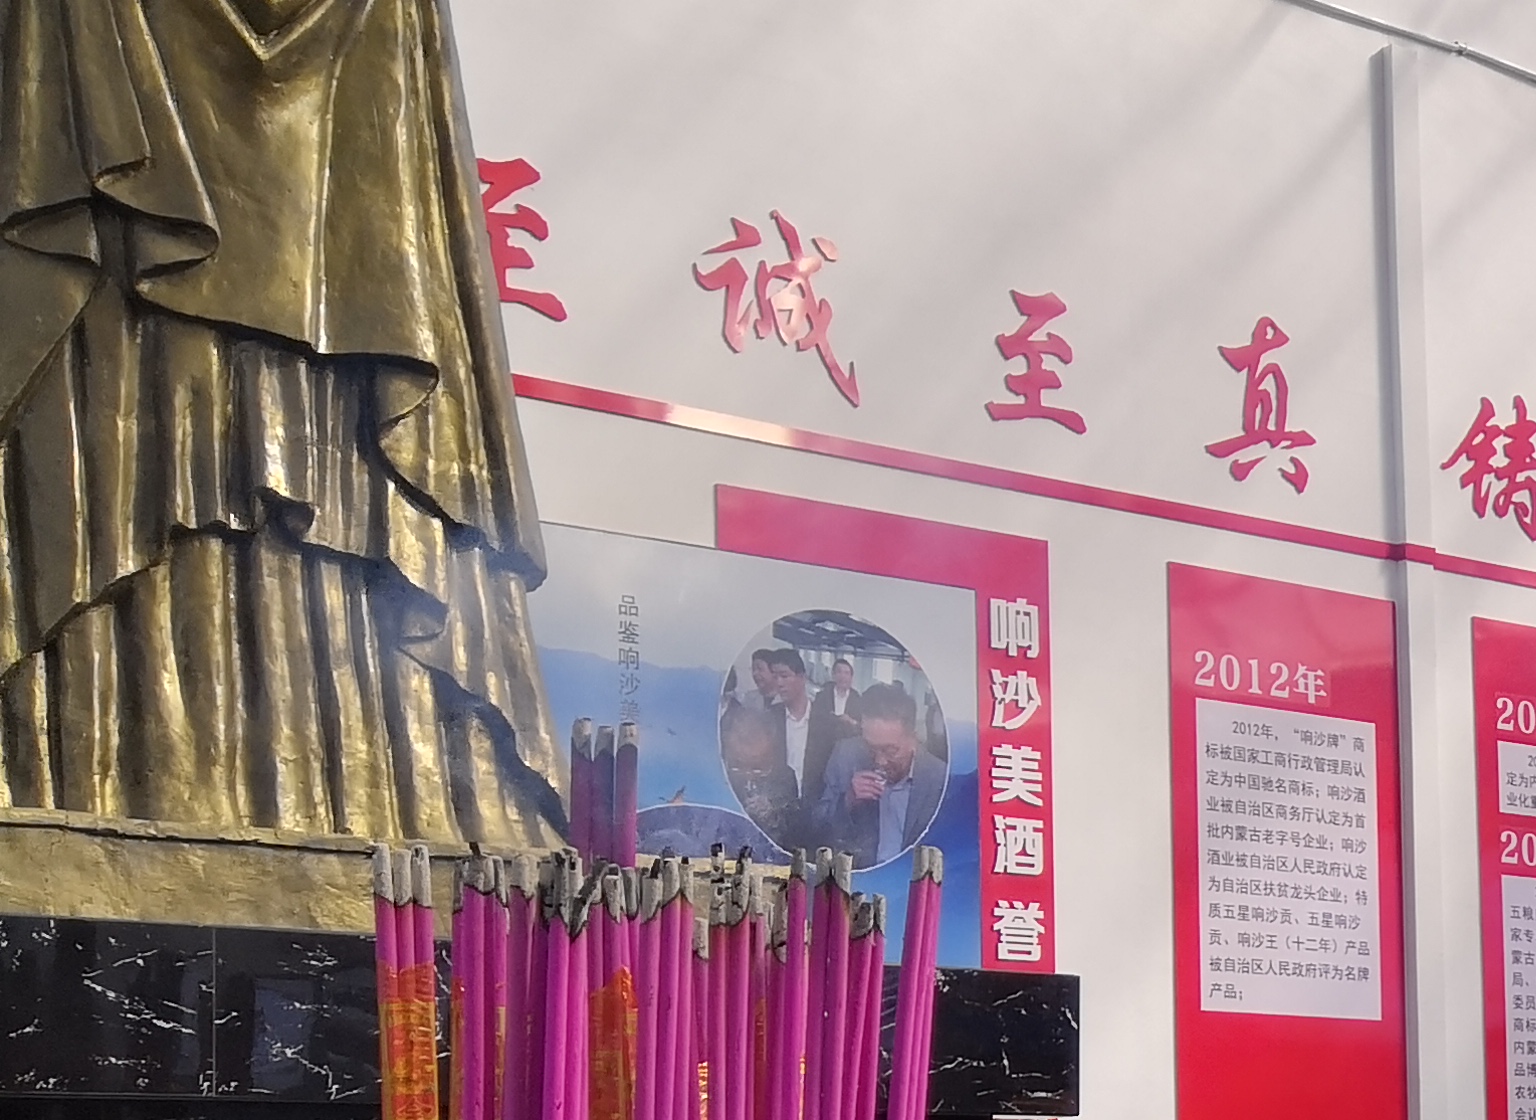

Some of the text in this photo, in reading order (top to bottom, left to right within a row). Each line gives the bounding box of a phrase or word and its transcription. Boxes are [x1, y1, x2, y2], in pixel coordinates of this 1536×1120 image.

[1194, 650, 1328, 704] 2012年
[1205, 742, 1366, 778] 标被国家工商行政管理局认
[1206, 768, 1366, 804] 定为中国驰名商标；响沙酒
[1206, 795, 1366, 829] 业被自治区商务厅认定为首
[1207, 821, 1367, 854] 批内蒙古老字号企业；响沙
[1207, 848, 1368, 880] 酒业被自治区人民政府认定
[1209, 957, 1370, 982] 被自治区人民政府评为名牌
[1209, 982, 1243, 1001] 产品；
